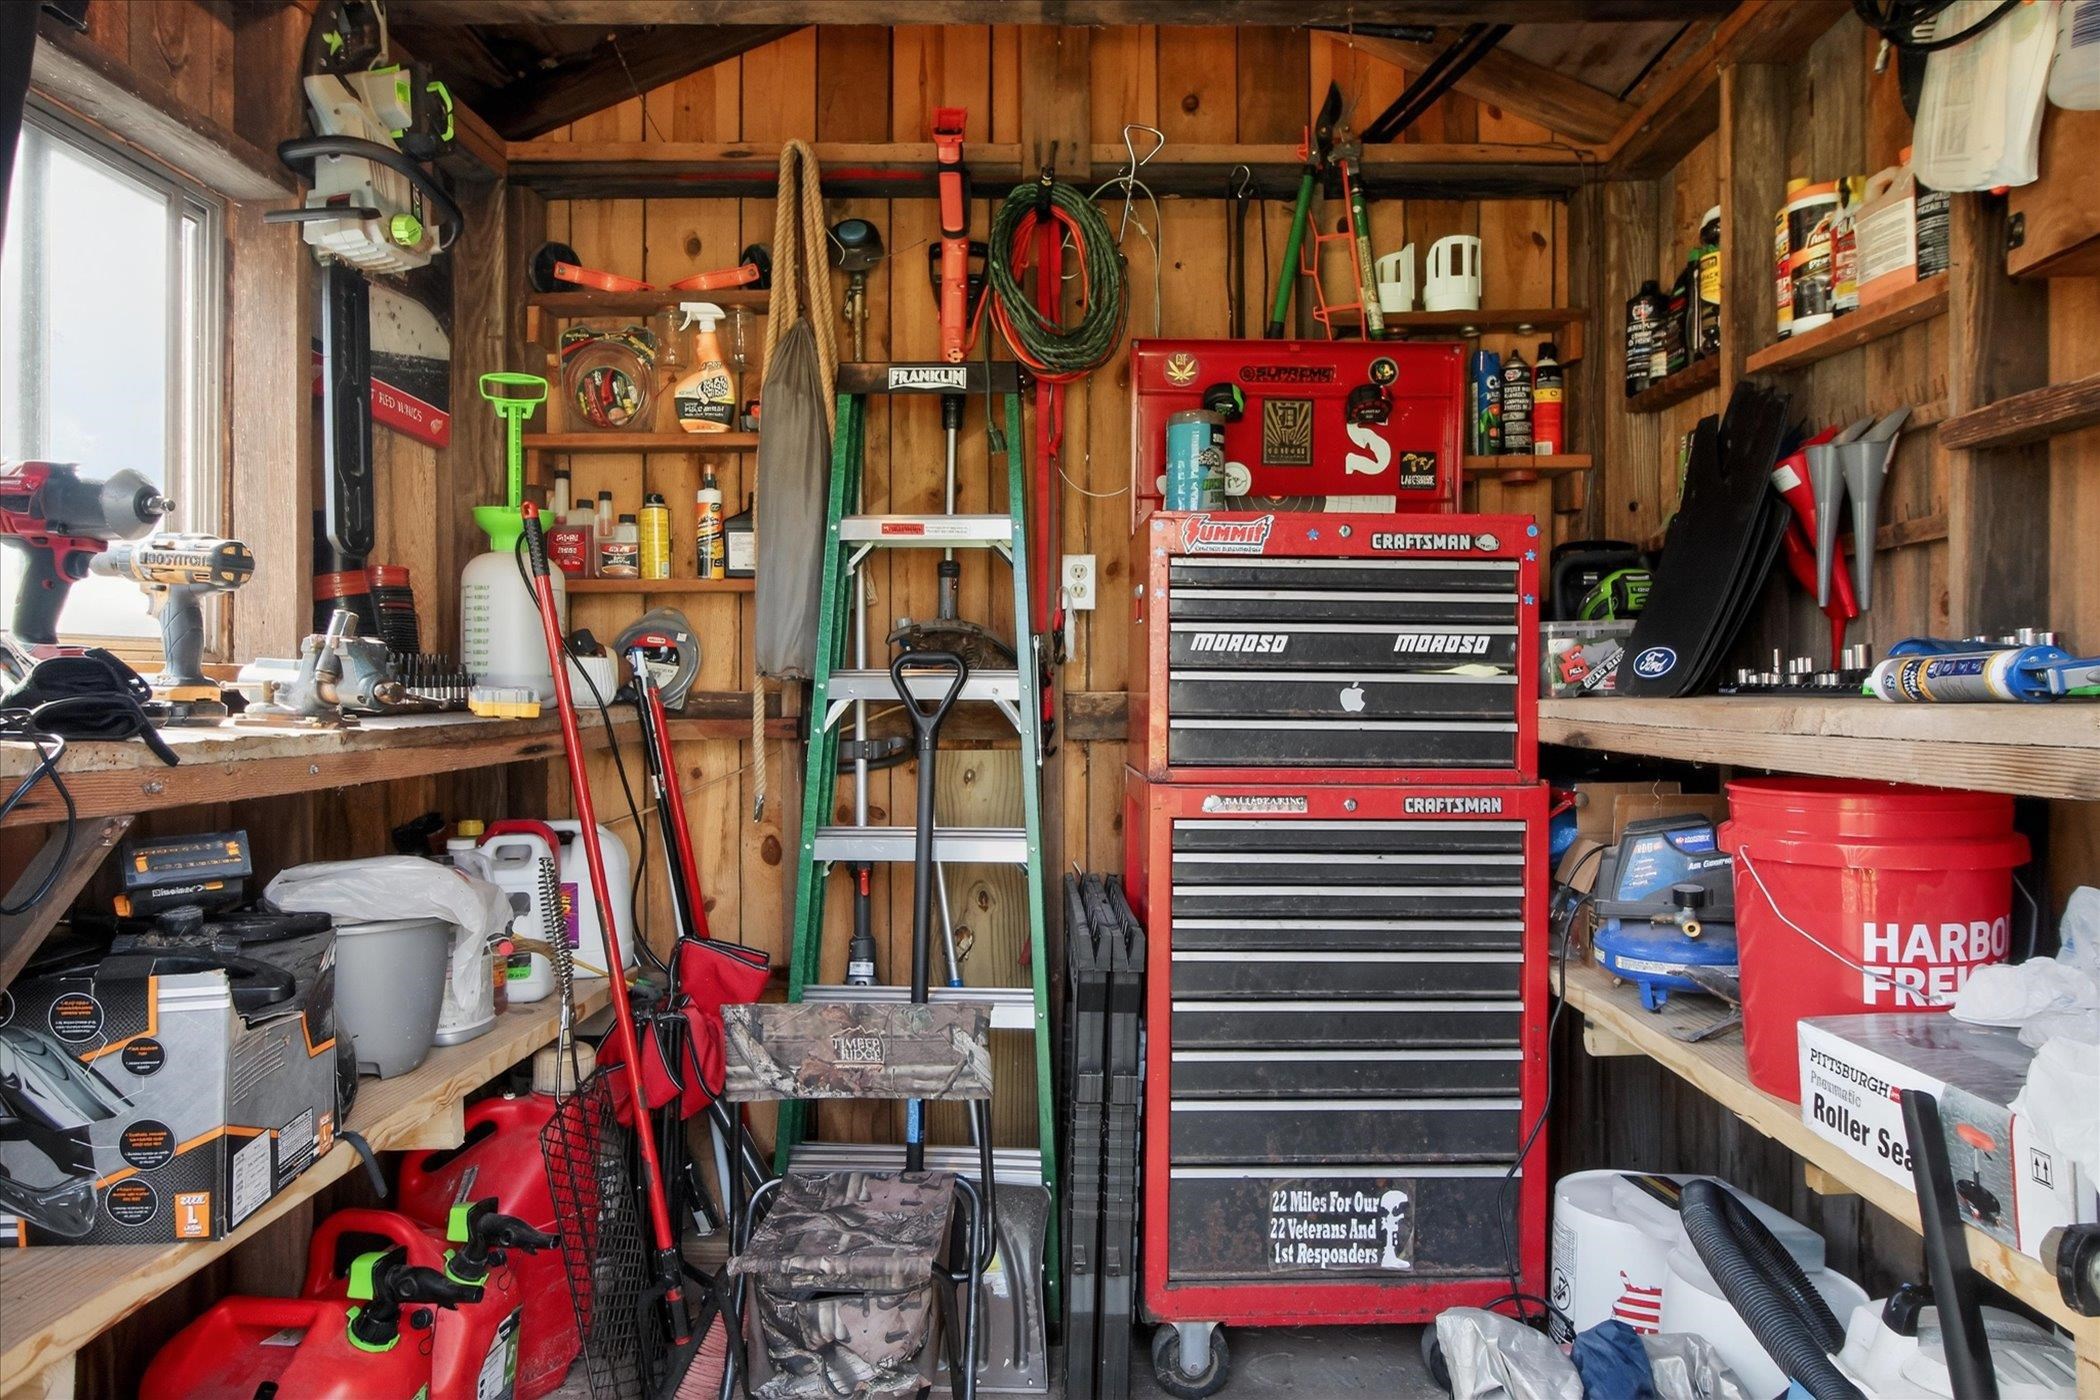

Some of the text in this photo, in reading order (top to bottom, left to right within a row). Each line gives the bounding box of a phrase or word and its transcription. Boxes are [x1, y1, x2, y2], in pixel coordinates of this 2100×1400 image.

[891, 369, 964, 387] FRANKLIN
[378, 391, 396, 409] RED
[1371, 532, 1471, 551] CRAFTSMAN
[1190, 633, 1289, 653] MOROSO
[1393, 634, 1491, 654] MOROSO
[1638, 650, 1669, 673] Ford
[1404, 796, 1502, 814] CRAFTSMAN
[1863, 916, 2009, 963] HARBO
[1863, 965, 1973, 1006] FREI
[1810, 1047, 1890, 1099] PITTSBURGH
[1810, 1070, 1862, 1108] Pneumatic
[1813, 1091, 1871, 1147] Roller
[1877, 1127, 1914, 1172] Sea
[1272, 1190, 1380, 1213] 22 Miles For Our
[1270, 1217, 1377, 1240] 22 Veterans And
[1274, 1242, 1379, 1269] 1st Responders
